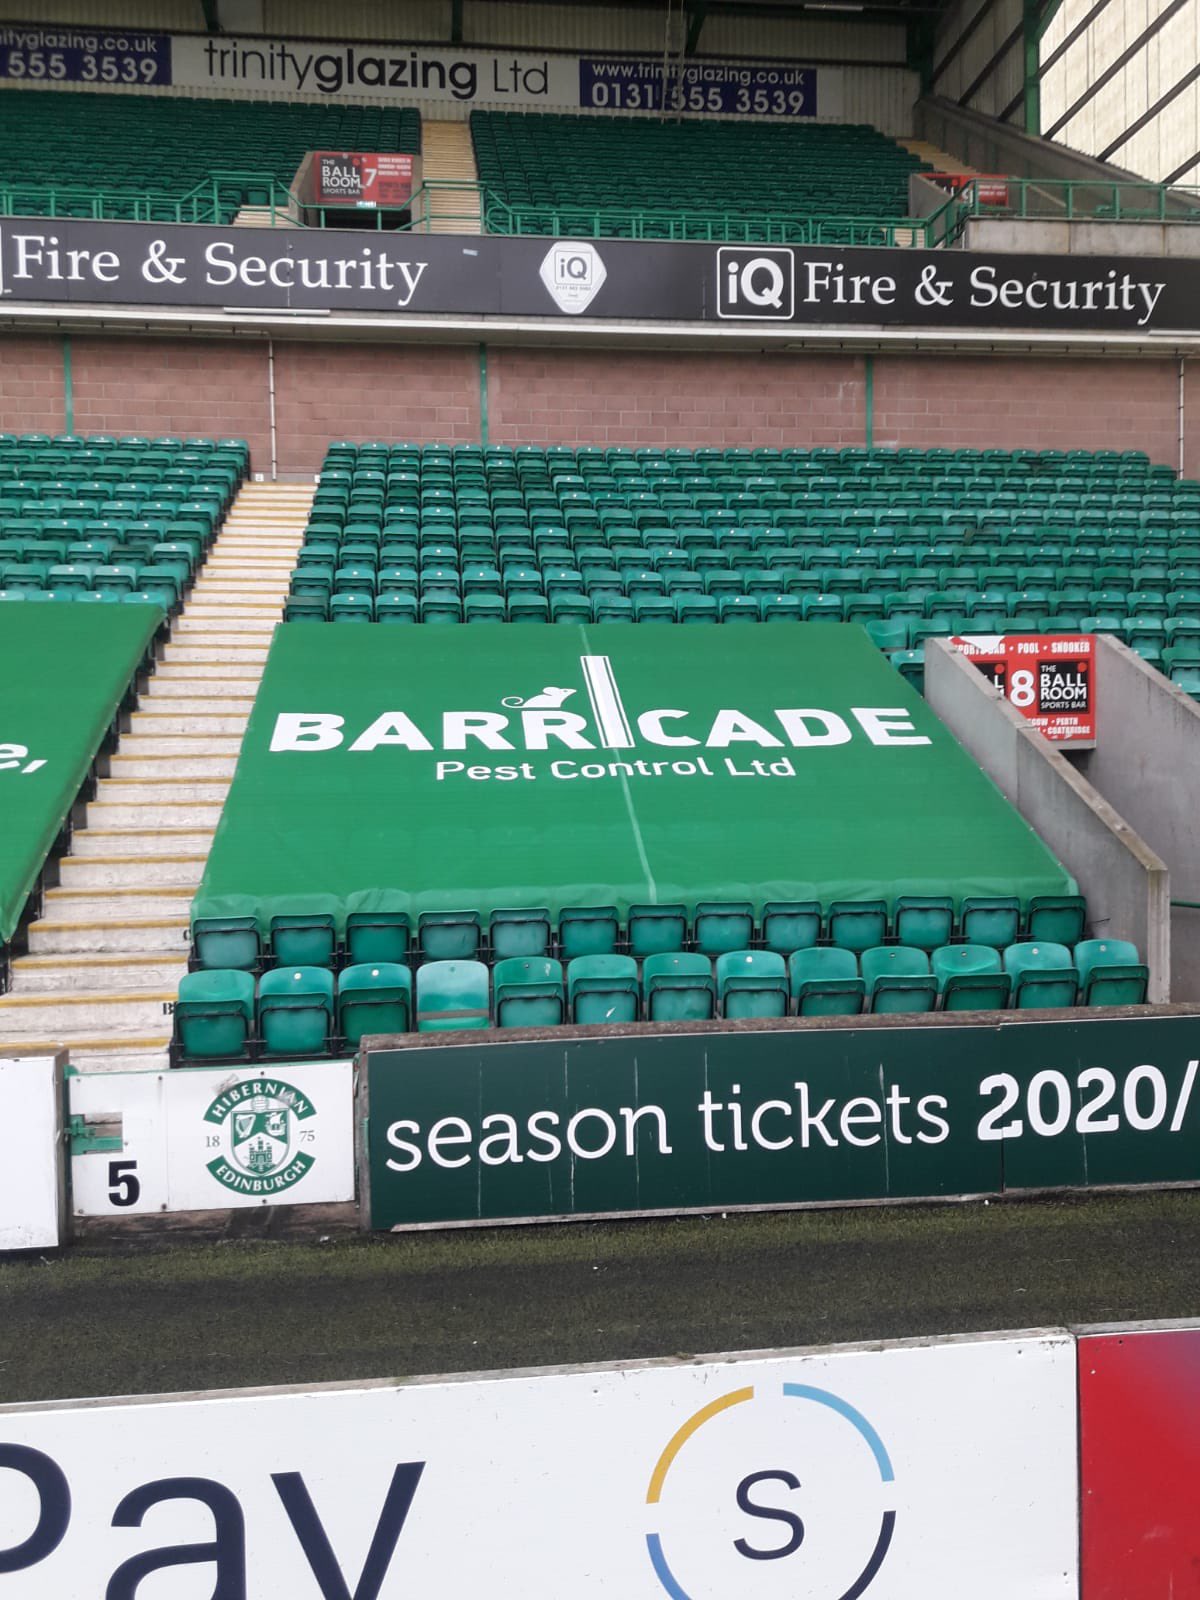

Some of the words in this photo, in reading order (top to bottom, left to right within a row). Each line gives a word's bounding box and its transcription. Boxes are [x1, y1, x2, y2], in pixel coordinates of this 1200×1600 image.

[8, 53, 66, 79] 555
[82, 56, 158, 83] 3539
[204, 41, 477, 100] trinityglazing
[493, 59, 548, 95] Ltd
[592, 83, 654, 108] 0131
[736, 89, 804, 114] 3539
[322, 166, 360, 177] BALL
[322, 177, 361, 188] ROOM
[364, 168, 377, 187] 7
[11, 235, 120, 282] Fire
[142, 240, 187, 284] &
[204, 242, 428, 306] Security
[560, 256, 587, 280] iQ
[728, 258, 784, 308] iQ
[803, 262, 897, 305] Fire
[914, 265, 953, 306] &
[970, 266, 1166, 325] Security
[1017, 642, 1040, 654] POOL
[1051, 641, 1090, 653] SNOOKER
[1040, 665, 1057, 673] THE
[1040, 673, 1086, 688] BALL
[1010, 669, 1036, 707] 8
[1040, 687, 1087, 700] ROOM
[269, 656, 932, 751] BARRICADE
[1040, 701, 1070, 709] SPORTS
[1072, 701, 1087, 709] BAR
[436, 760, 536, 781] Pest
[551, 757, 713, 780] Control
[724, 758, 797, 777] Ltd
[212, 1082, 309, 1118] HIBERNIAN
[386, 1103, 673, 1172] season
[698, 1081, 950, 1153] tickets
[977, 1060, 1200, 1141] 2020/
[206, 1136, 220, 1147] 18
[300, 1130, 315, 1141] 75
[108, 1160, 140, 1207] 5
[215, 1160, 306, 1192] EDINBURGH
[733, 1470, 805, 1560] S
